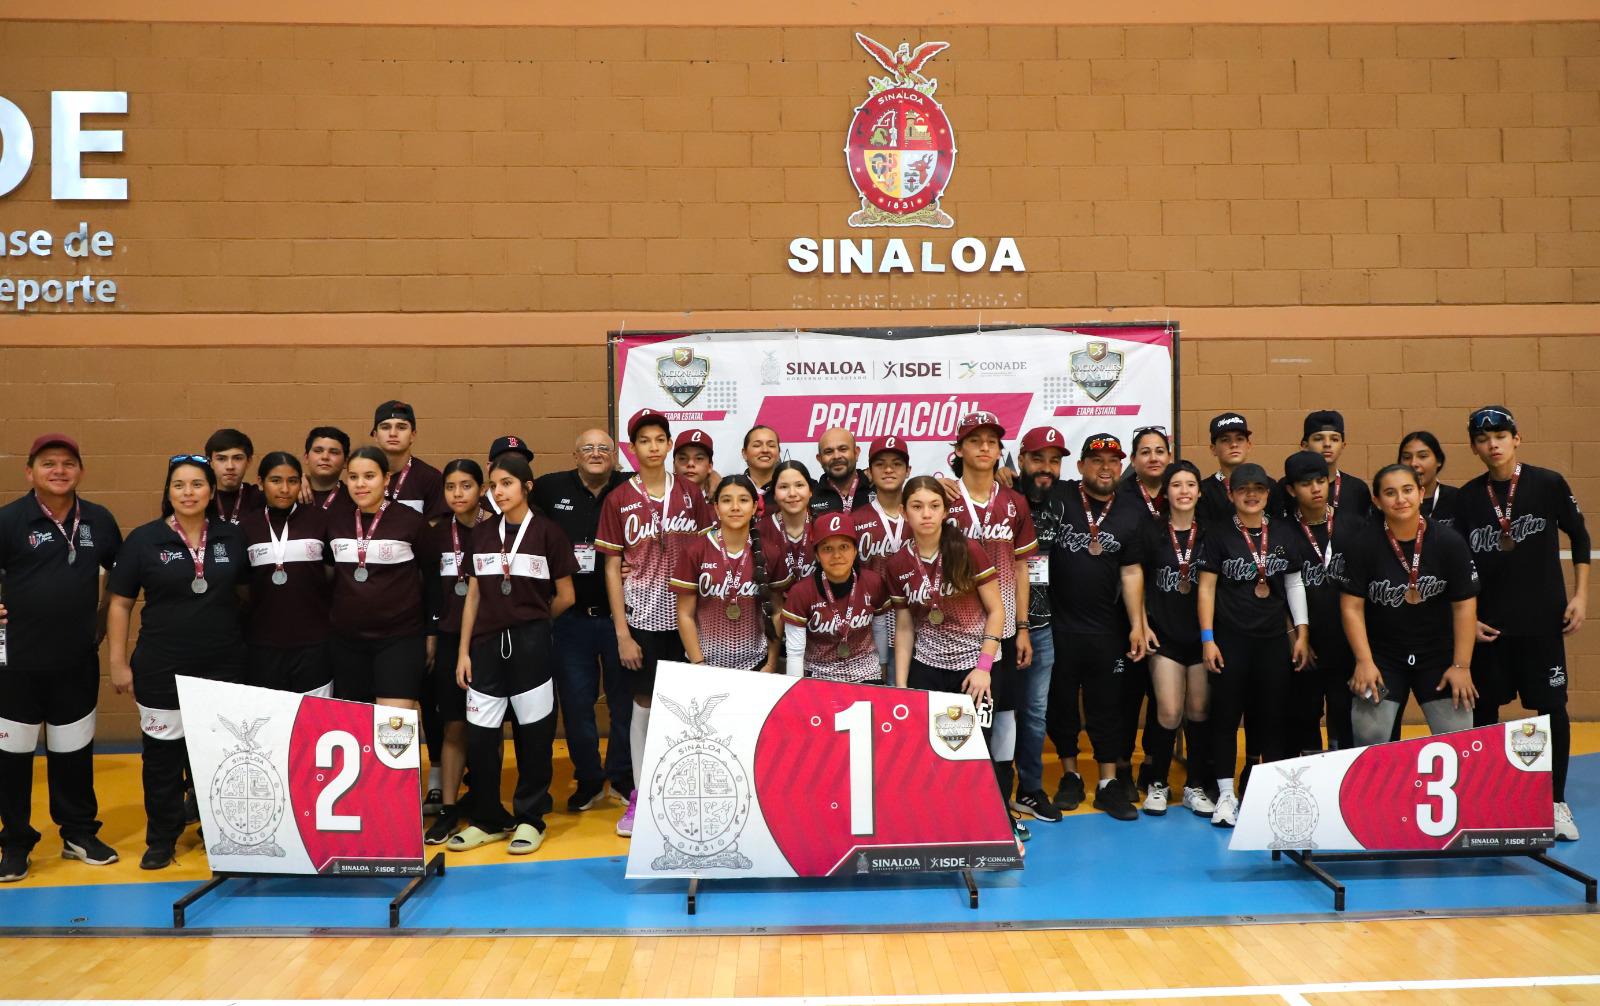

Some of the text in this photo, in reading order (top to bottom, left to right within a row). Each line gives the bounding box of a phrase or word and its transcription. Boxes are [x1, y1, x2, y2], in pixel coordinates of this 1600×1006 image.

[877, 93, 924, 105] SINALOA
[887, 200, 914, 209] 1831
[64, 222, 114, 257] de
[787, 237, 1026, 274] SINALOA
[0, 275, 117, 310] eporte
[786, 361, 1027, 377] SINALOA ISDE CONADE
[681, 412, 703, 420] ESTATAL
[1077, 407, 1117, 415] ETAPA ESTATAL
[691, 432, 701, 442] C
[1046, 429, 1055, 442] C
[885, 437, 895, 448] C
[620, 502, 643, 513] IMDEC
[830, 516, 840, 531] C
[855, 520, 878, 531] IMDEC
[701, 562, 717, 570] DEC
[678, 744, 722, 755] SINALOA
[232, 757, 264, 765] SINALOA
[834, 700, 873, 835] 1
[316, 730, 360, 830] 2
[1416, 741, 1458, 837] 3
[872, 858, 920, 868] SINALOA
[940, 857, 965, 868] ISDE
